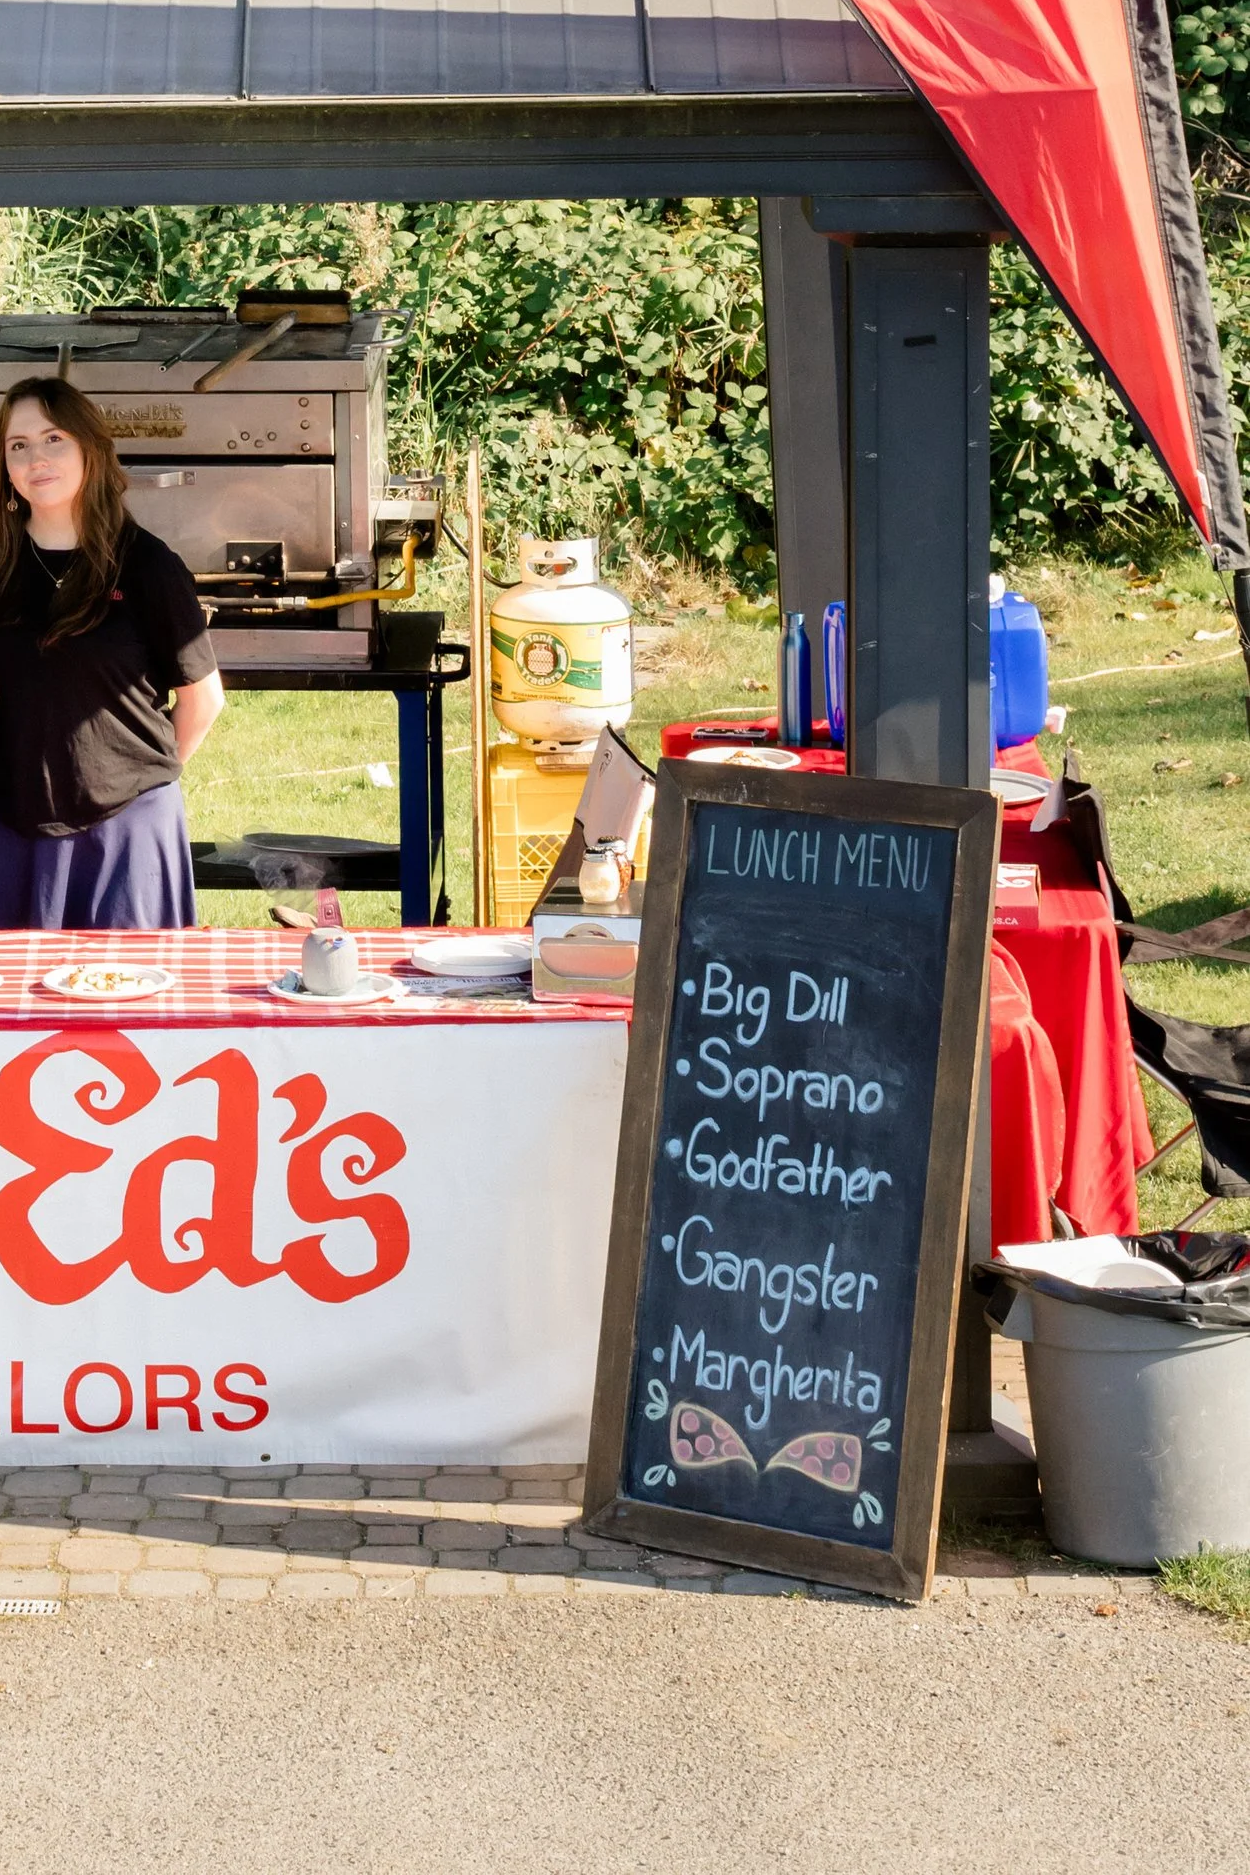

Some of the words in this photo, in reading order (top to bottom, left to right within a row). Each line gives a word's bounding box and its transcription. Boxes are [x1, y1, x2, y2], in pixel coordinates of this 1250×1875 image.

[521, 667, 562, 685] Traders
[526, 634, 555, 645] Tank
[706, 824, 820, 885] LUNCH
[834, 828, 933, 893] MENU
[700, 962, 770, 1048] Big
[786, 970, 849, 1028] Dill
[696, 1038, 884, 1124] Soprano
[686, 1118, 893, 1211] Godfather
[673, 1214, 879, 1335] Gangster
[669, 1324, 882, 1431] Margherita
